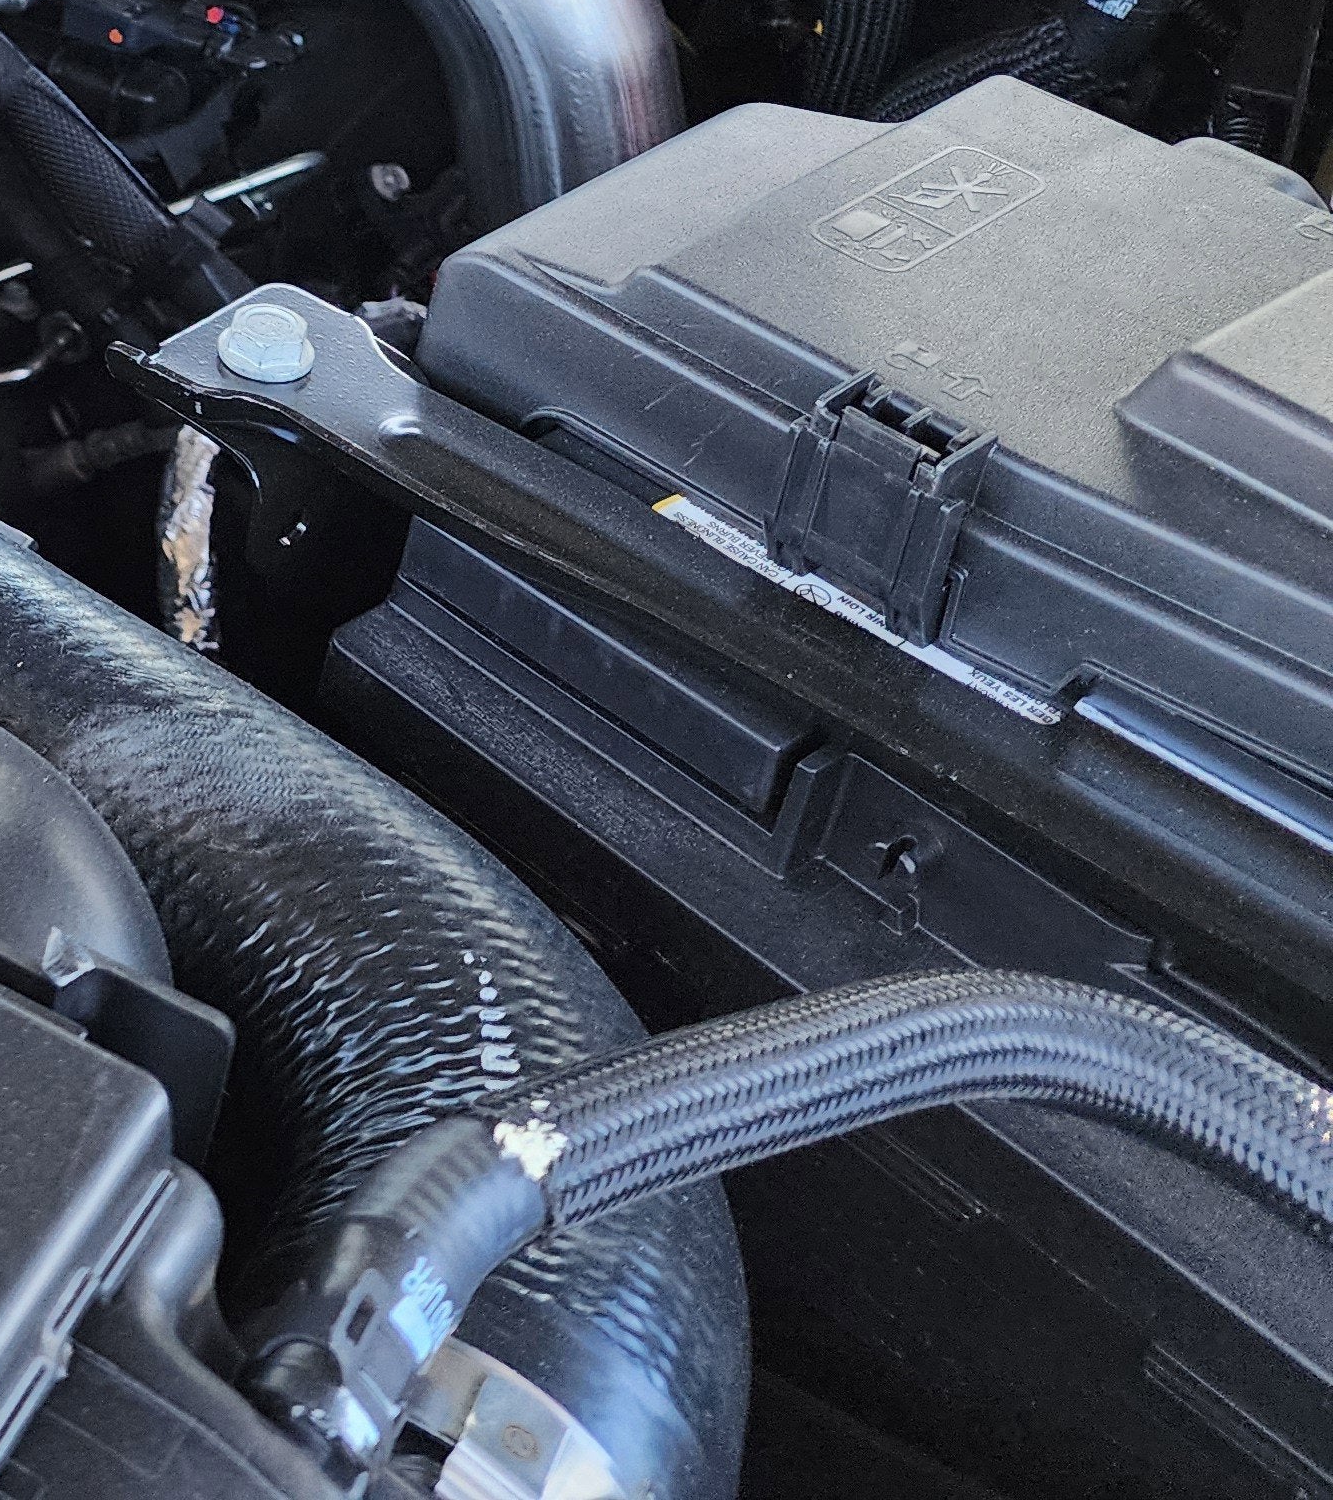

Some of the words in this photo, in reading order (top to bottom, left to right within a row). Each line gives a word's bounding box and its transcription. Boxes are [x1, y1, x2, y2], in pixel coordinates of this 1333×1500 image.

[673, 511, 725, 544] BLINDNESS
[706, 520, 739, 542] BURNS
[724, 543, 757, 564] CAUSE
[754, 562, 779, 577] CAN
[836, 595, 865, 614] LOIN
[969, 668, 1001, 690] YEUX
[1002, 690, 1027, 706] LES
